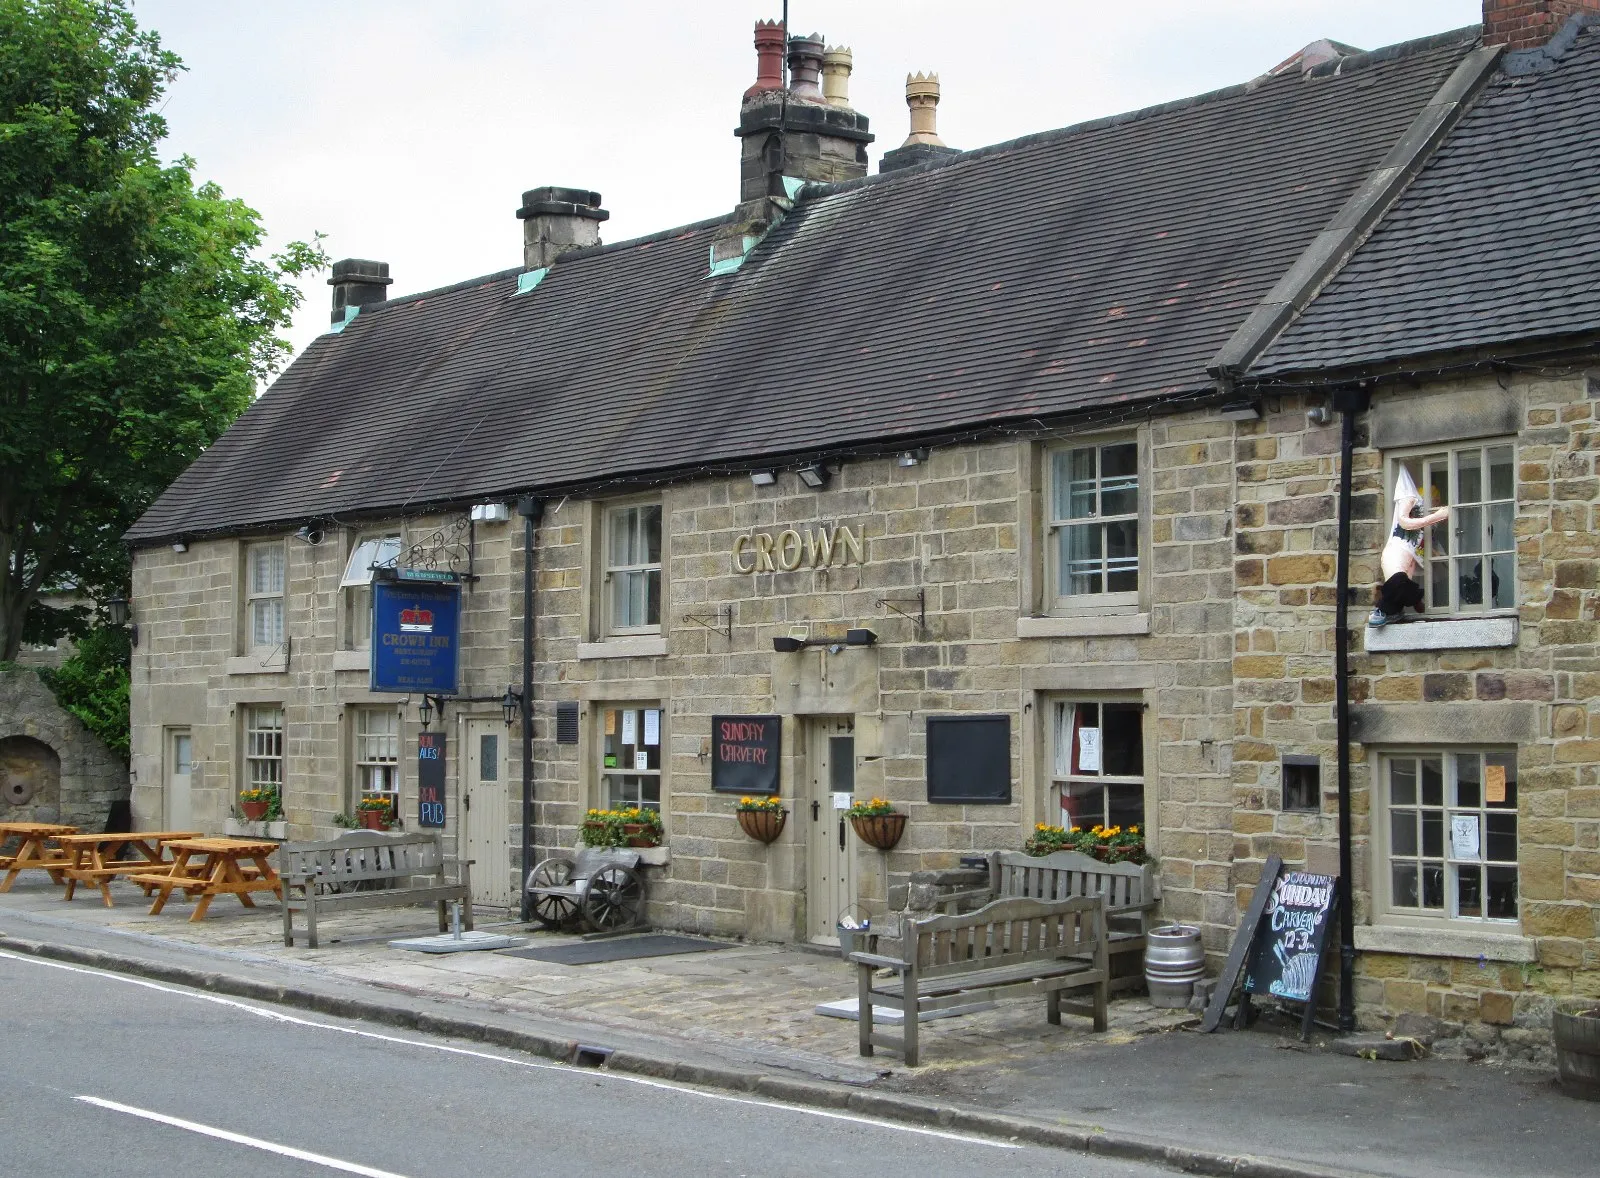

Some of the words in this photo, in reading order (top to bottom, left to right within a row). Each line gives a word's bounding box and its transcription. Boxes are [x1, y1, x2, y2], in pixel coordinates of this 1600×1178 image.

[732, 523, 865, 574] CROWN
[382, 633, 426, 647] CROWN
[429, 635, 450, 648] INN
[721, 721, 765, 741] SUNDAY
[420, 736, 434, 747] REAL
[720, 743, 768, 765] CARVERY
[420, 786, 439, 802] REAL
[421, 802, 444, 823] PUB
